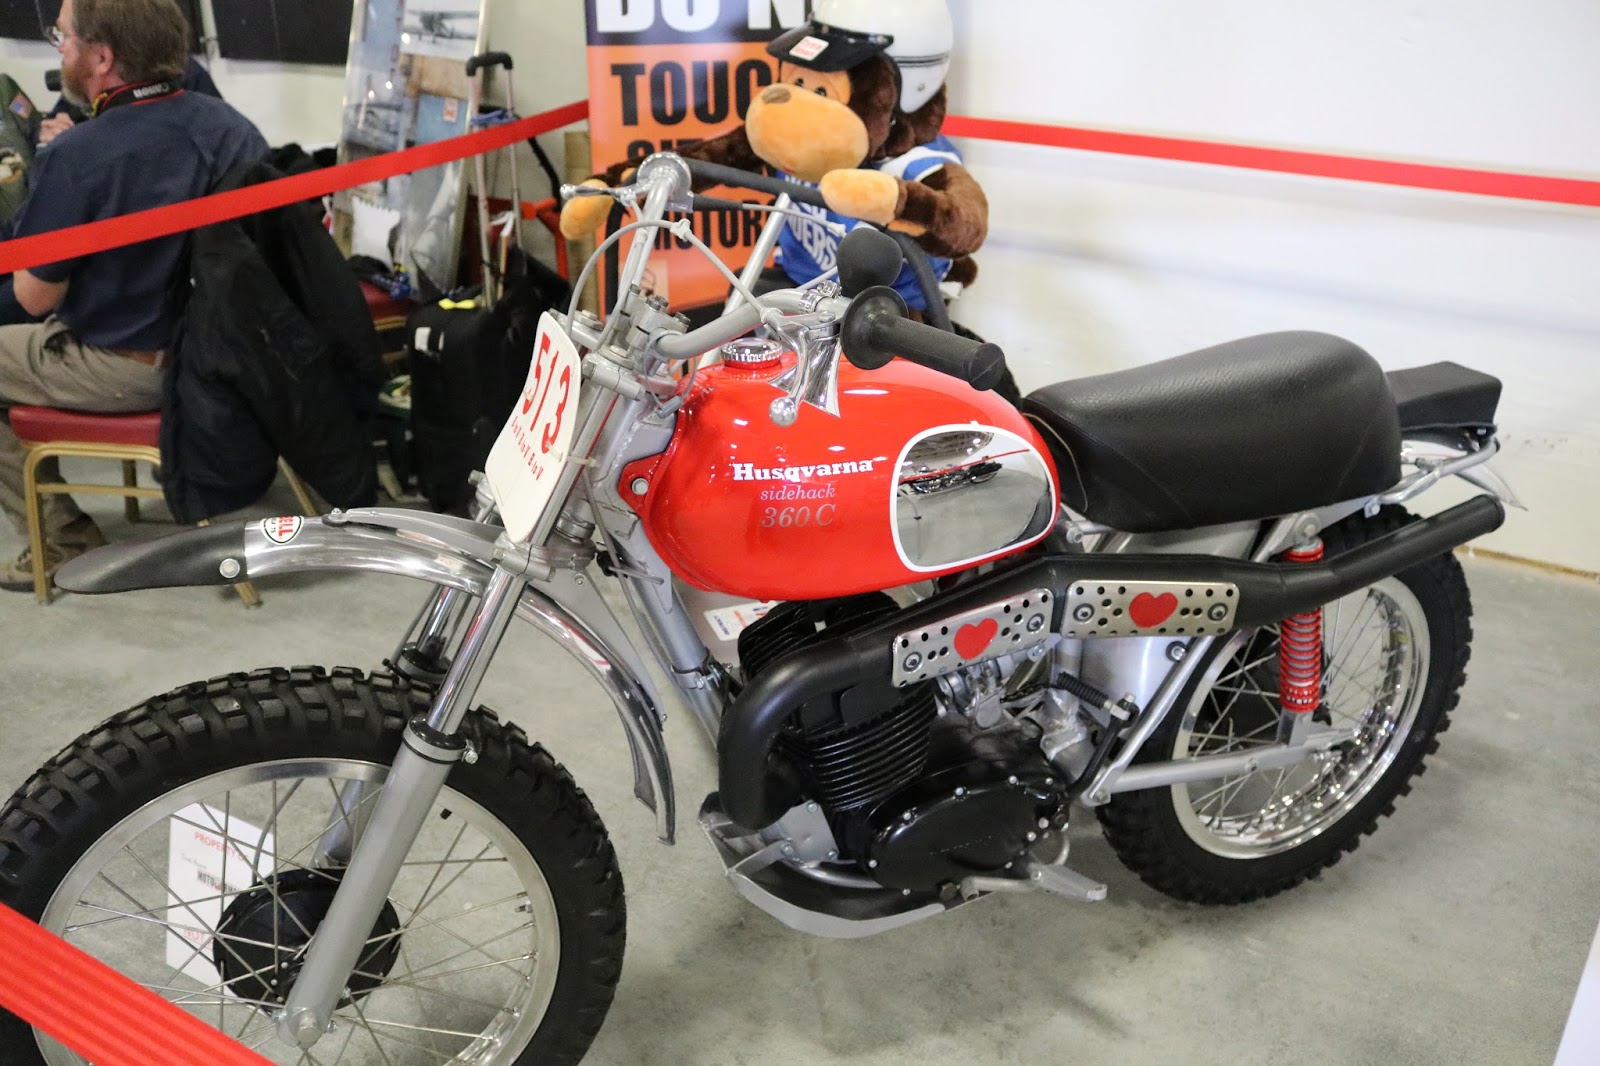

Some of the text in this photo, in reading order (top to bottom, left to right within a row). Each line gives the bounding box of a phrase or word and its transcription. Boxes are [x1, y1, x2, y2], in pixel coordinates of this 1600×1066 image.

[611, 60, 772, 126] TOUC
[522, 331, 571, 454] 513
[732, 459, 874, 483] Husqvarna
[760, 483, 836, 501] sidehack
[760, 503, 836, 528] 360 C
